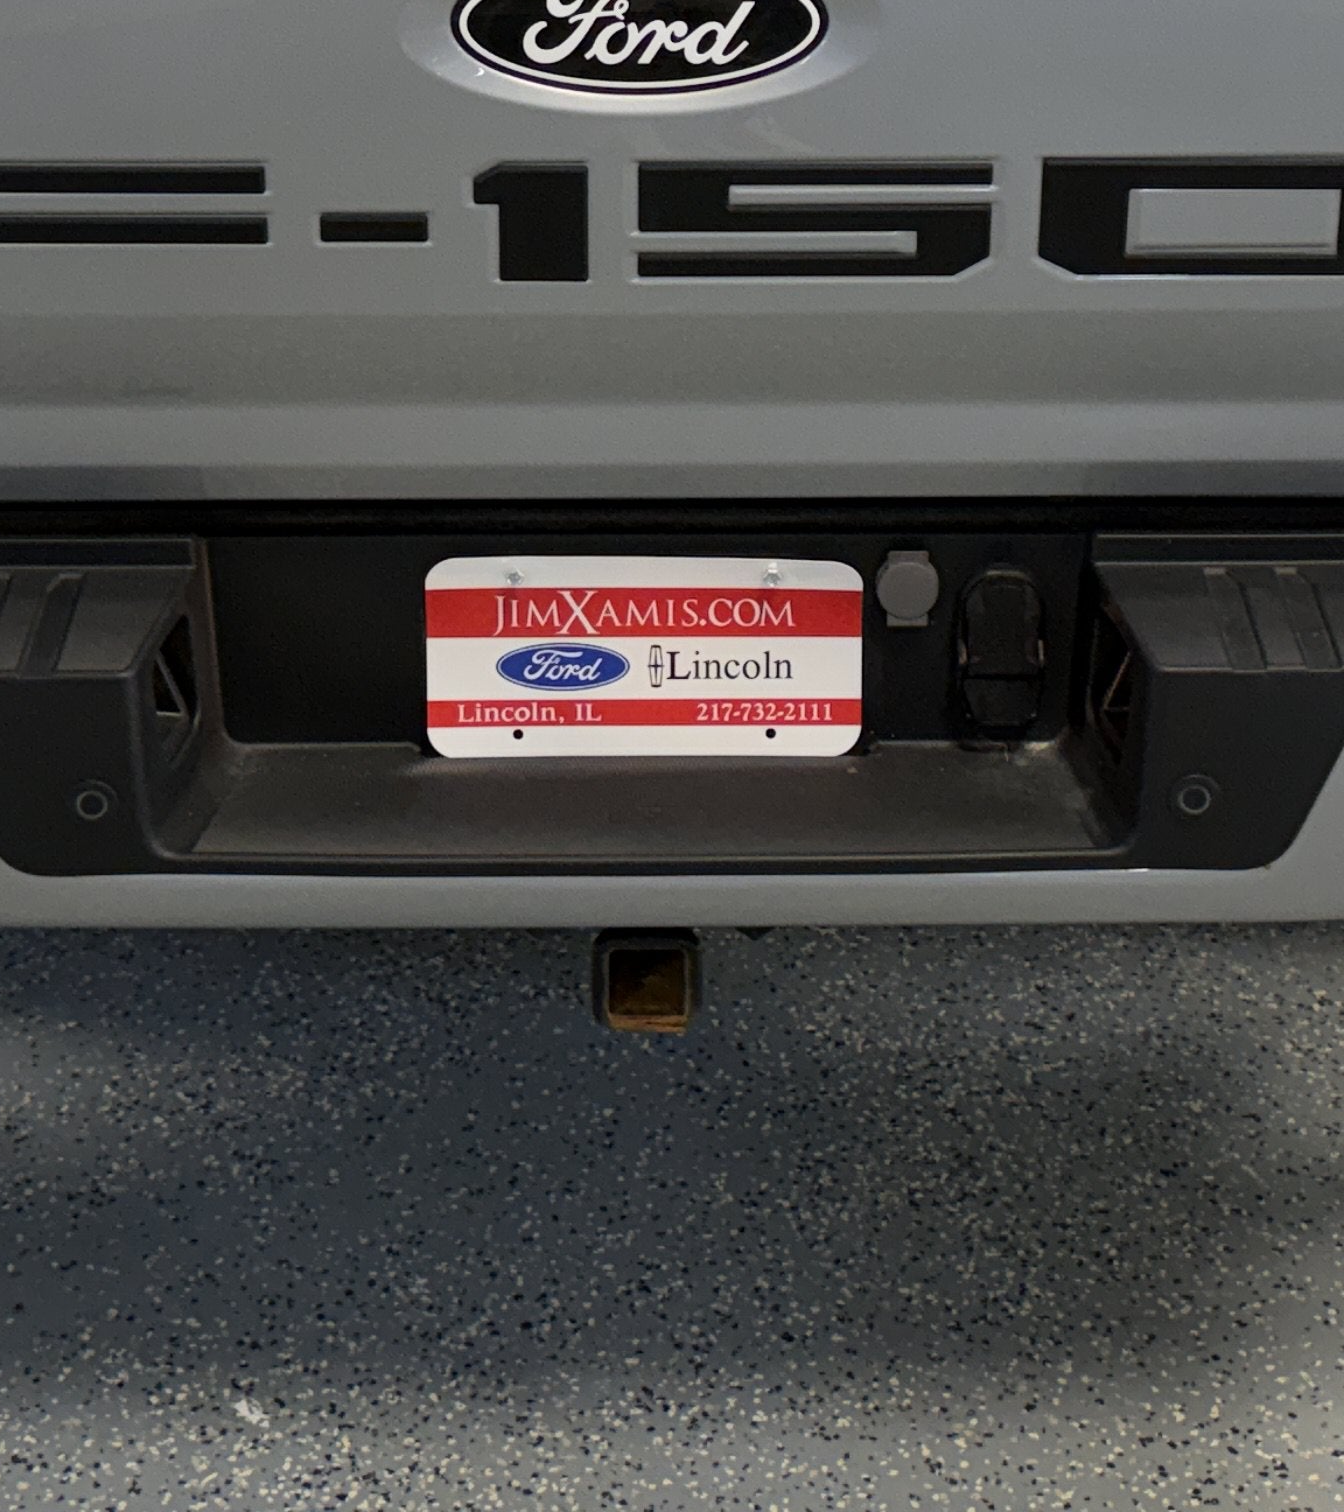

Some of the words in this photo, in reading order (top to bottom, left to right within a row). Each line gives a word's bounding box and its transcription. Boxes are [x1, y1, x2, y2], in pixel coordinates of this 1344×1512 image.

[493, 590, 797, 636] JIMXAMIS.COM
[523, 649, 603, 681] Ford
[666, 650, 793, 680] Lincoln
[457, 702, 565, 724] Lincoln,
[575, 703, 602, 722] IL
[696, 702, 832, 722] 217-732-2111
